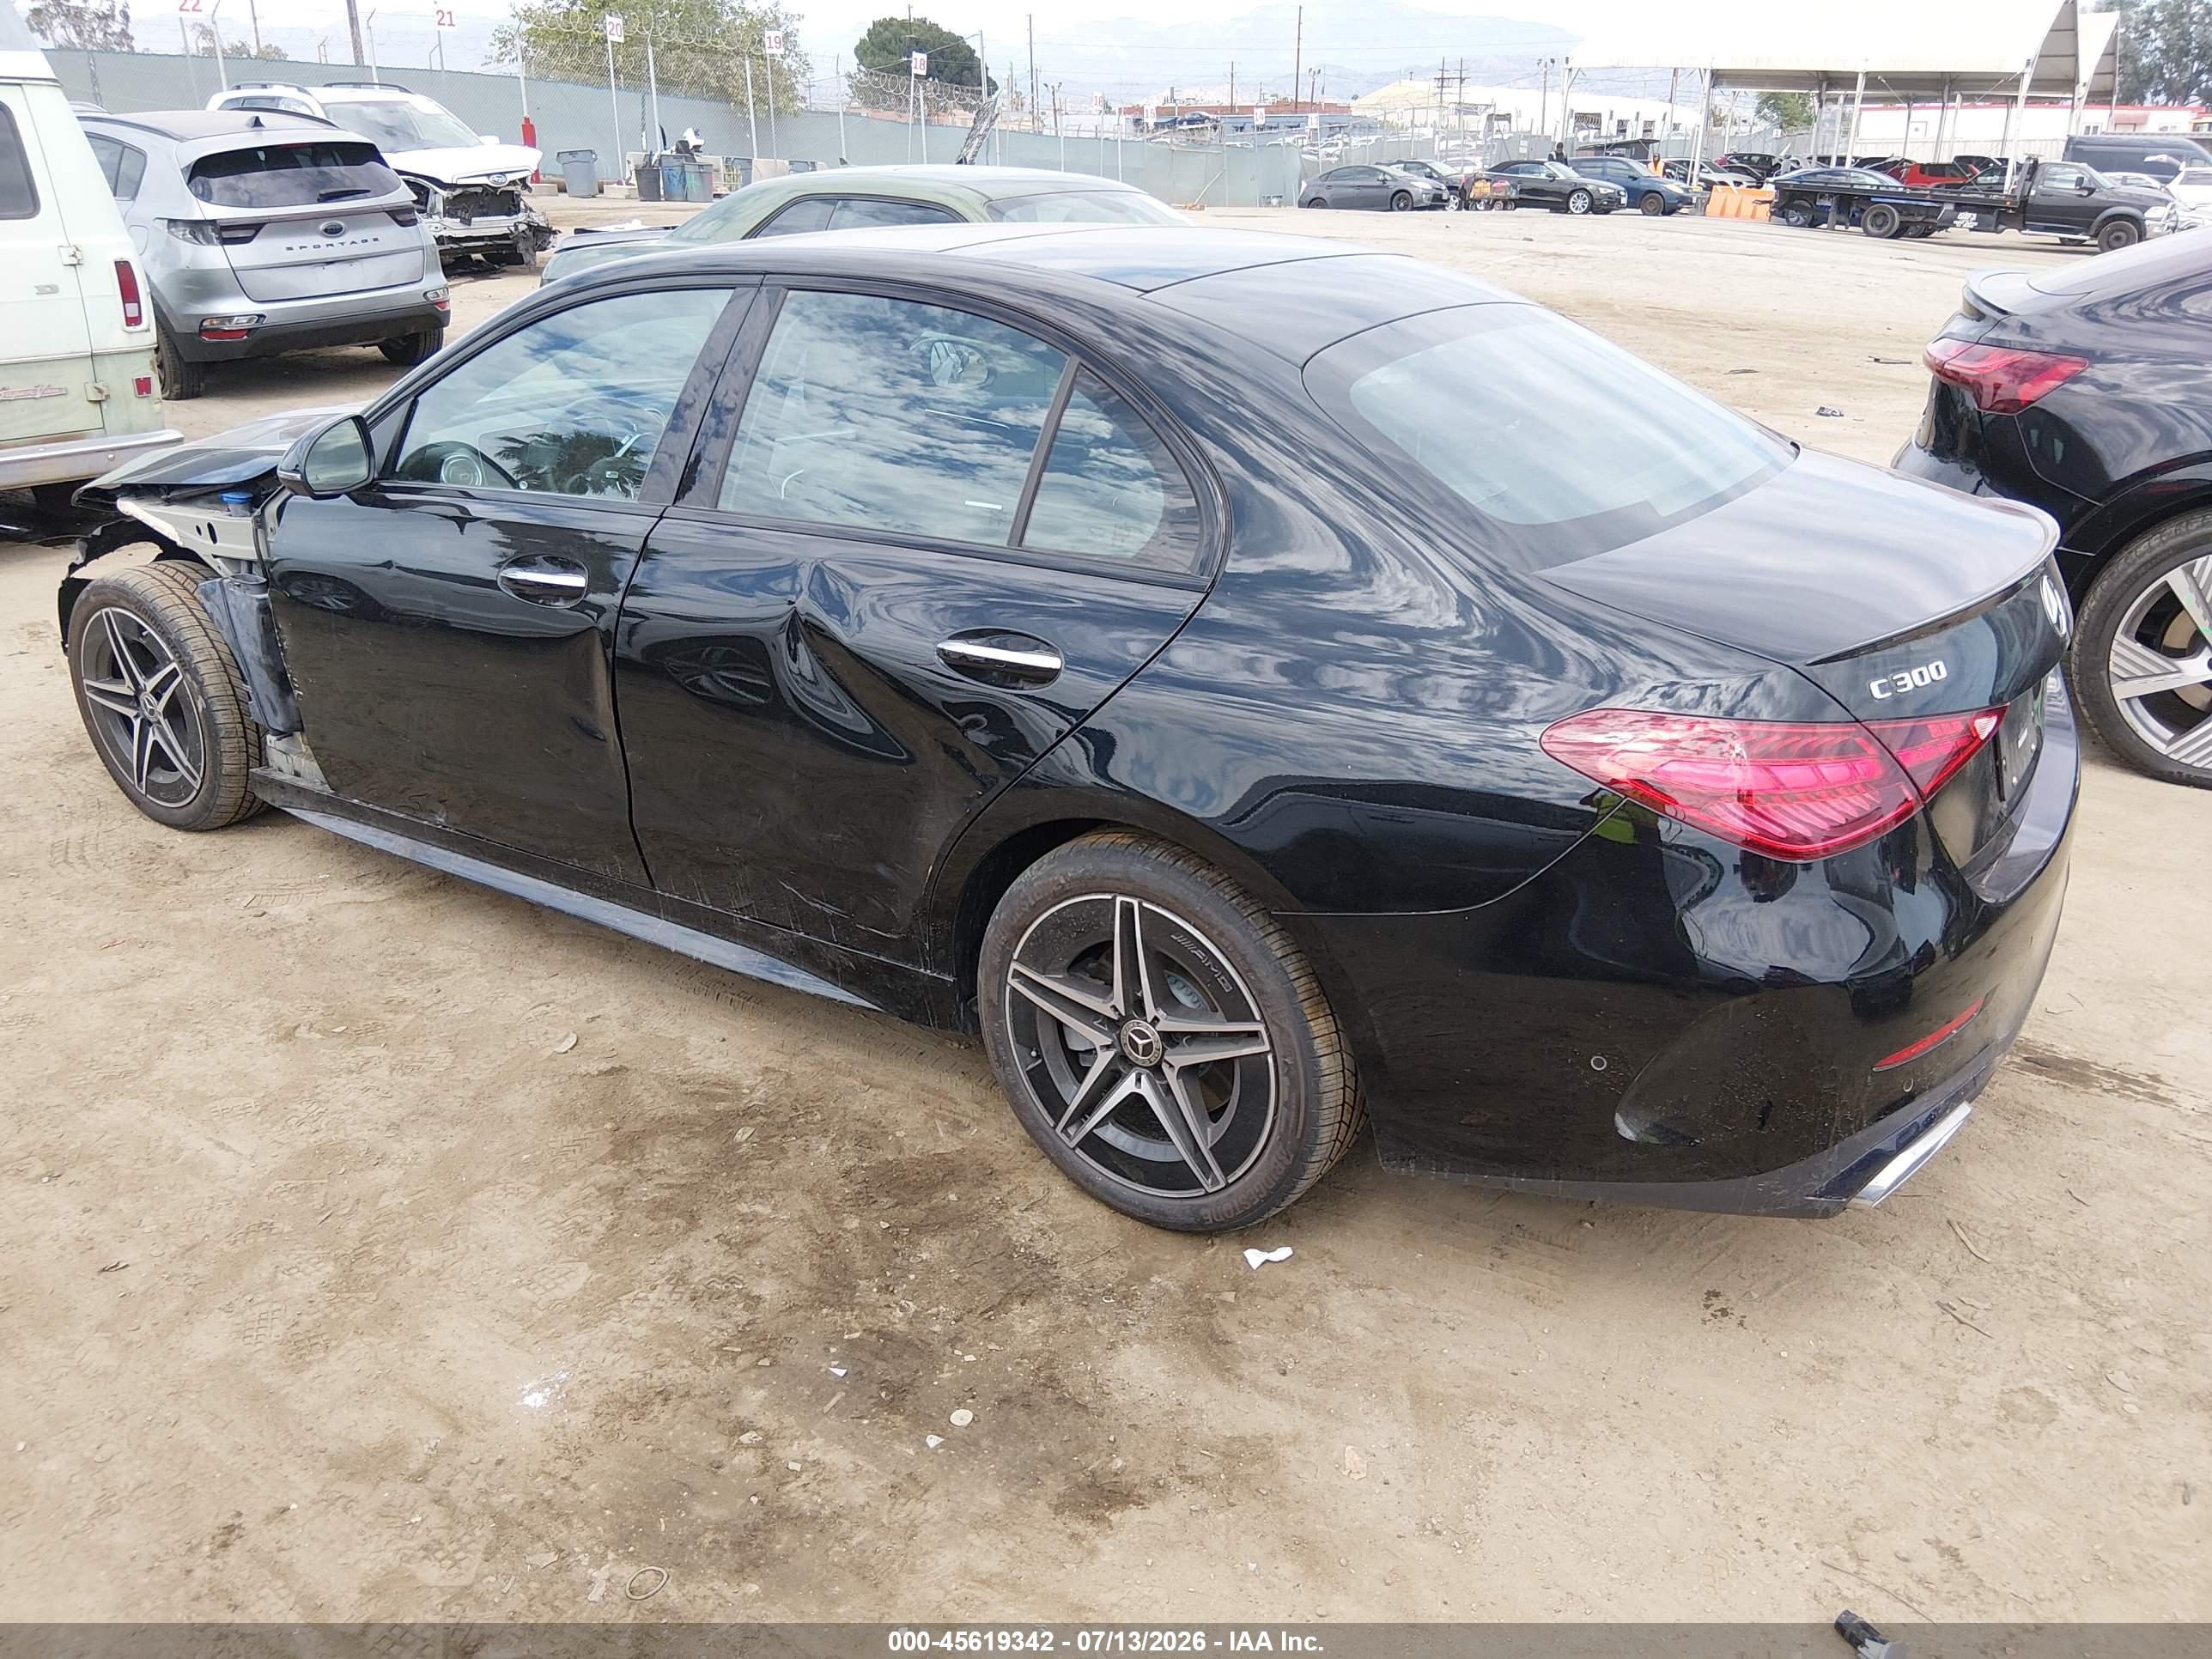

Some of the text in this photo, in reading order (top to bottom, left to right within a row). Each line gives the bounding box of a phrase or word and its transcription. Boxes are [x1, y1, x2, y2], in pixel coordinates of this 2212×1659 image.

[179, 0, 203, 12] 22
[436, 10, 456, 27] 21
[607, 22, 623, 38] 20
[766, 35, 783, 50] 19
[913, 58, 927, 70] 18
[1094, 95, 1103, 106] 16
[1146, 109, 1155, 118] 15
[286, 237, 380, 251] SPORTAGE
[1869, 660, 1948, 700] C 300
